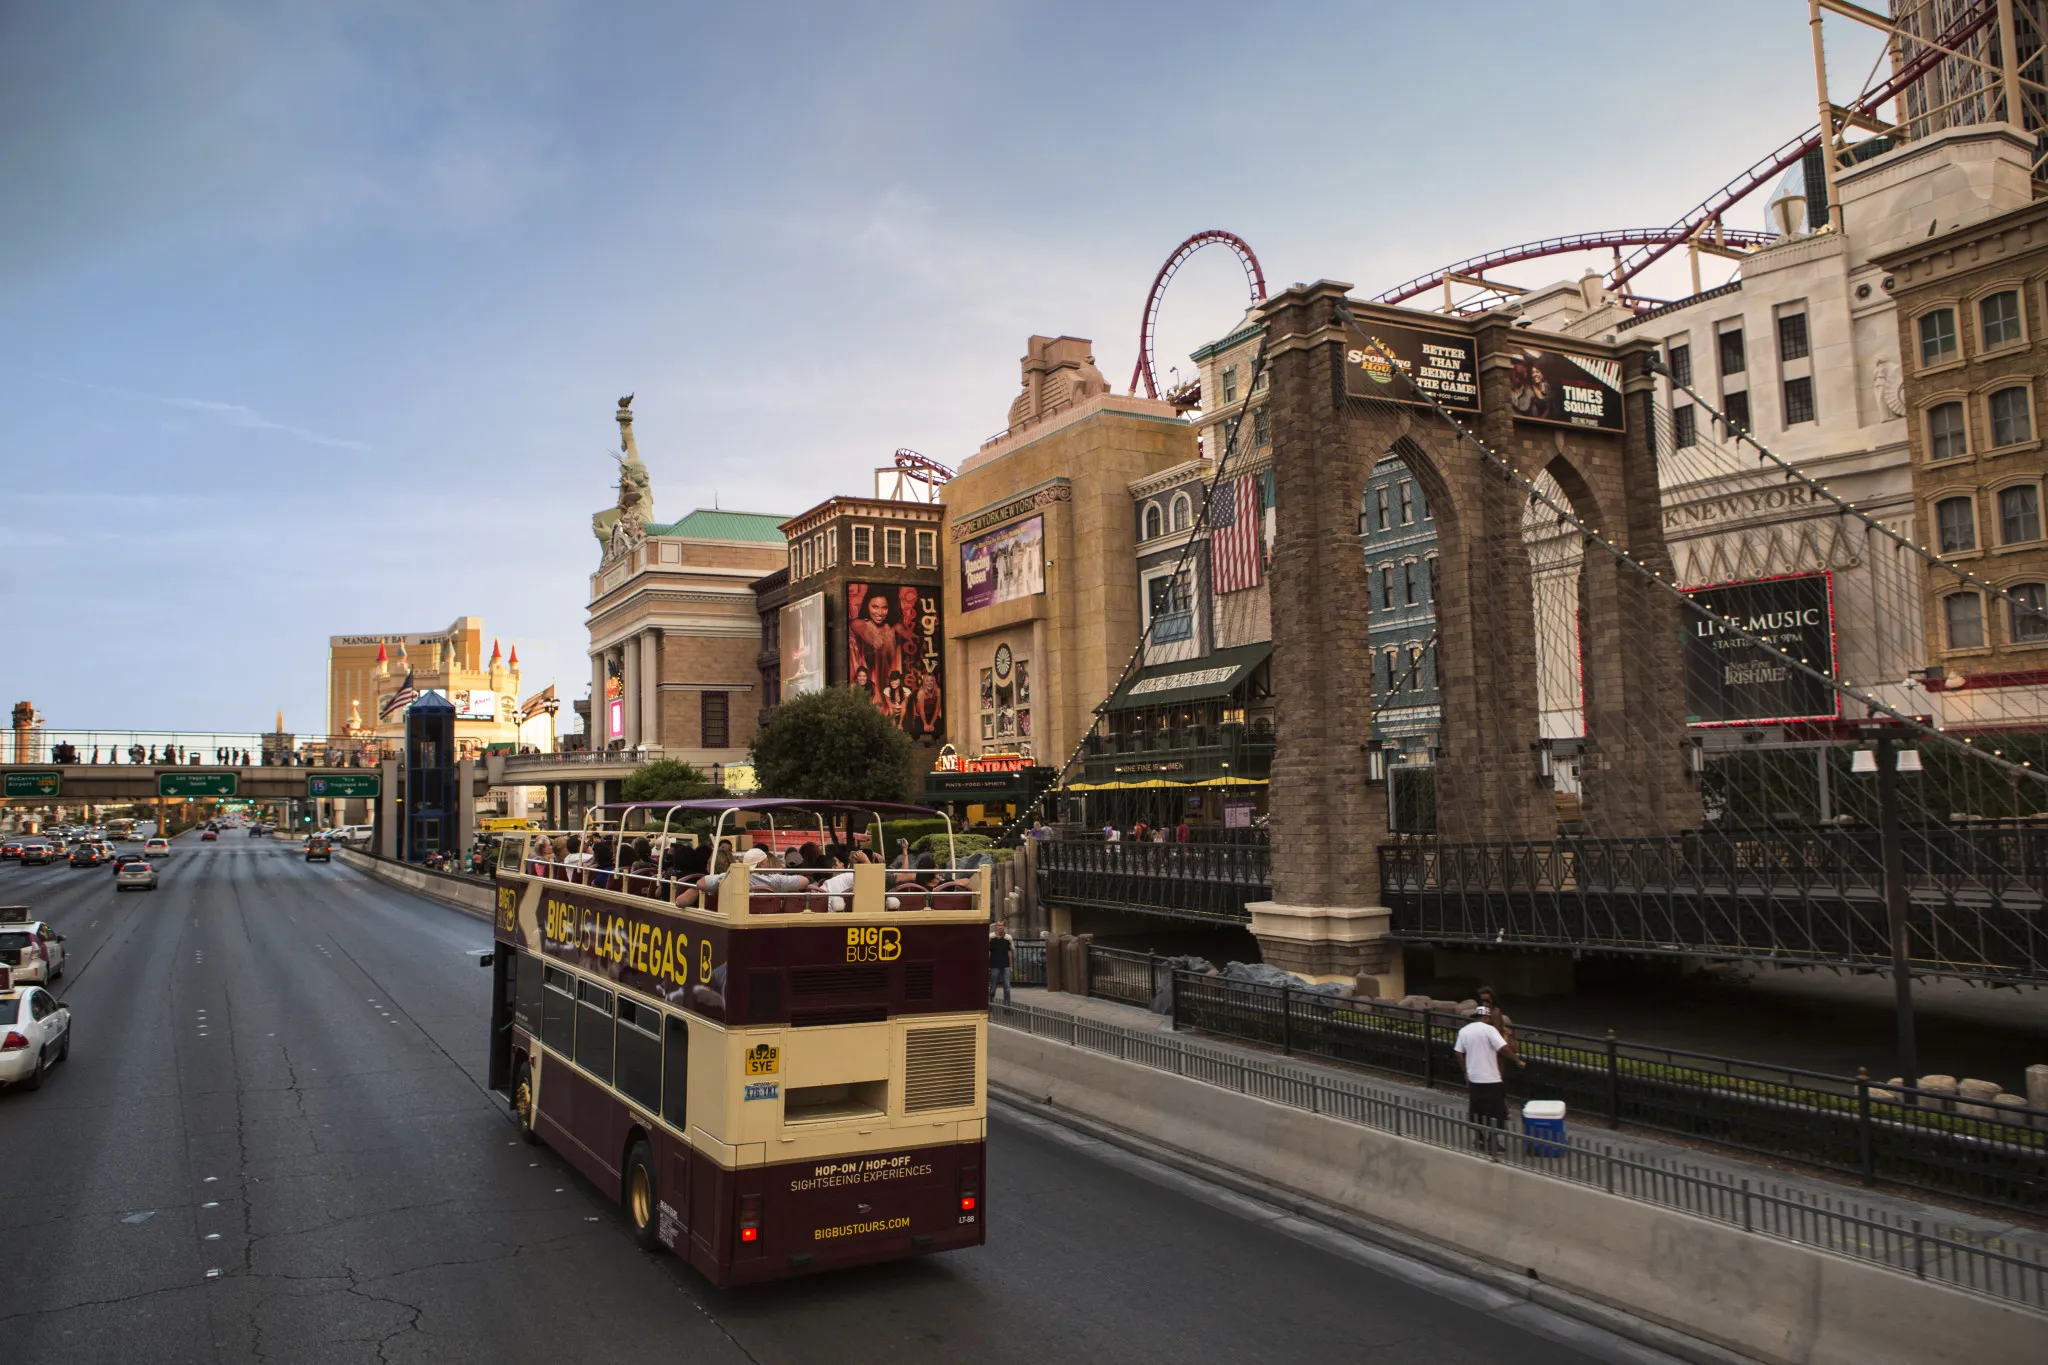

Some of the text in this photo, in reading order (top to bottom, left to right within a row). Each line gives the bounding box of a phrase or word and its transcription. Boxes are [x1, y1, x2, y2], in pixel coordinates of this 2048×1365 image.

[1348, 350, 1411, 367] SPORING
[1422, 344, 1465, 359] BETTER
[1429, 357, 1460, 369] THAN
[1420, 367, 1471, 382] BEING AT
[1416, 377, 1476, 394] THE GAME!
[1562, 385, 1604, 405] TIMES
[1563, 400, 1604, 417] SQUARE
[969, 496, 1035, 532] NEW YORK NEW YORK
[1684, 499, 1740, 522] NEW
[965, 554, 990, 576] Dancing
[967, 570, 987, 590] Queen
[1749, 608, 1820, 632] MUSIC
[391, 635, 408, 644] BAY
[1766, 634, 1779, 645] AT
[1137, 764, 1152, 772] FINE
[847, 927, 878, 946] BIG
[594, 911, 625, 963] LAS
[628, 919, 688, 986] VEGAS
[846, 946, 878, 962] BUS
[749, 1048, 777, 1060] A928
[752, 1060, 773, 1072] SYE
[815, 1162, 857, 1177] HOP-ON
[866, 1156, 911, 1171] HOP-OFF
[790, 1164, 932, 1192] SIGHTSEEING EXPERIENCES
[814, 1217, 910, 1241] BIGBUSTOURS.COM
